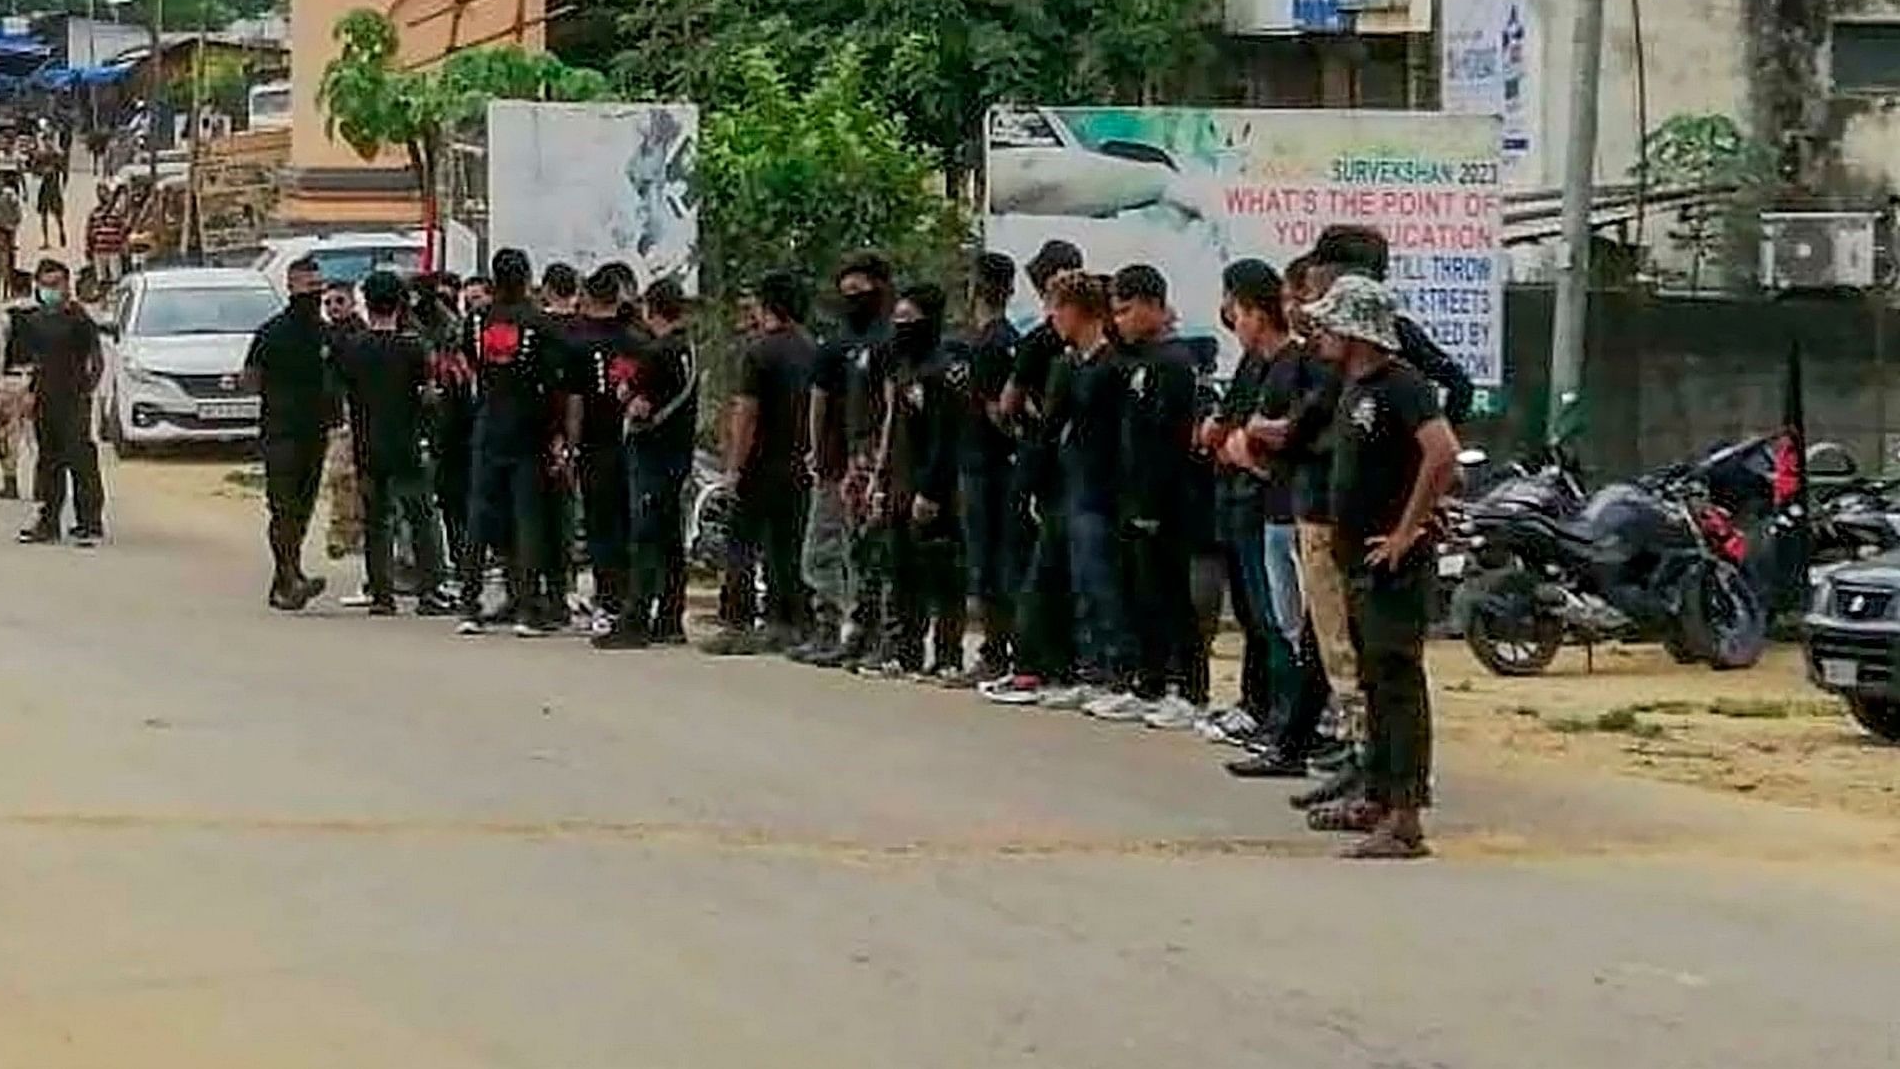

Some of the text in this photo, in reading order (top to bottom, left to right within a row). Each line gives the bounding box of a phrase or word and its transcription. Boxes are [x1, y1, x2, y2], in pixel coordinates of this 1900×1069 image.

[1331, 160, 1454, 183] SURVEKSHAN
[1326, 188, 1377, 216] THE
[1381, 189, 1458, 217] POINT
[1463, 191, 1499, 218] OF
[1434, 256, 1491, 281] THROW
[1418, 287, 1491, 314] STREETS
[1468, 320, 1490, 347] BY
